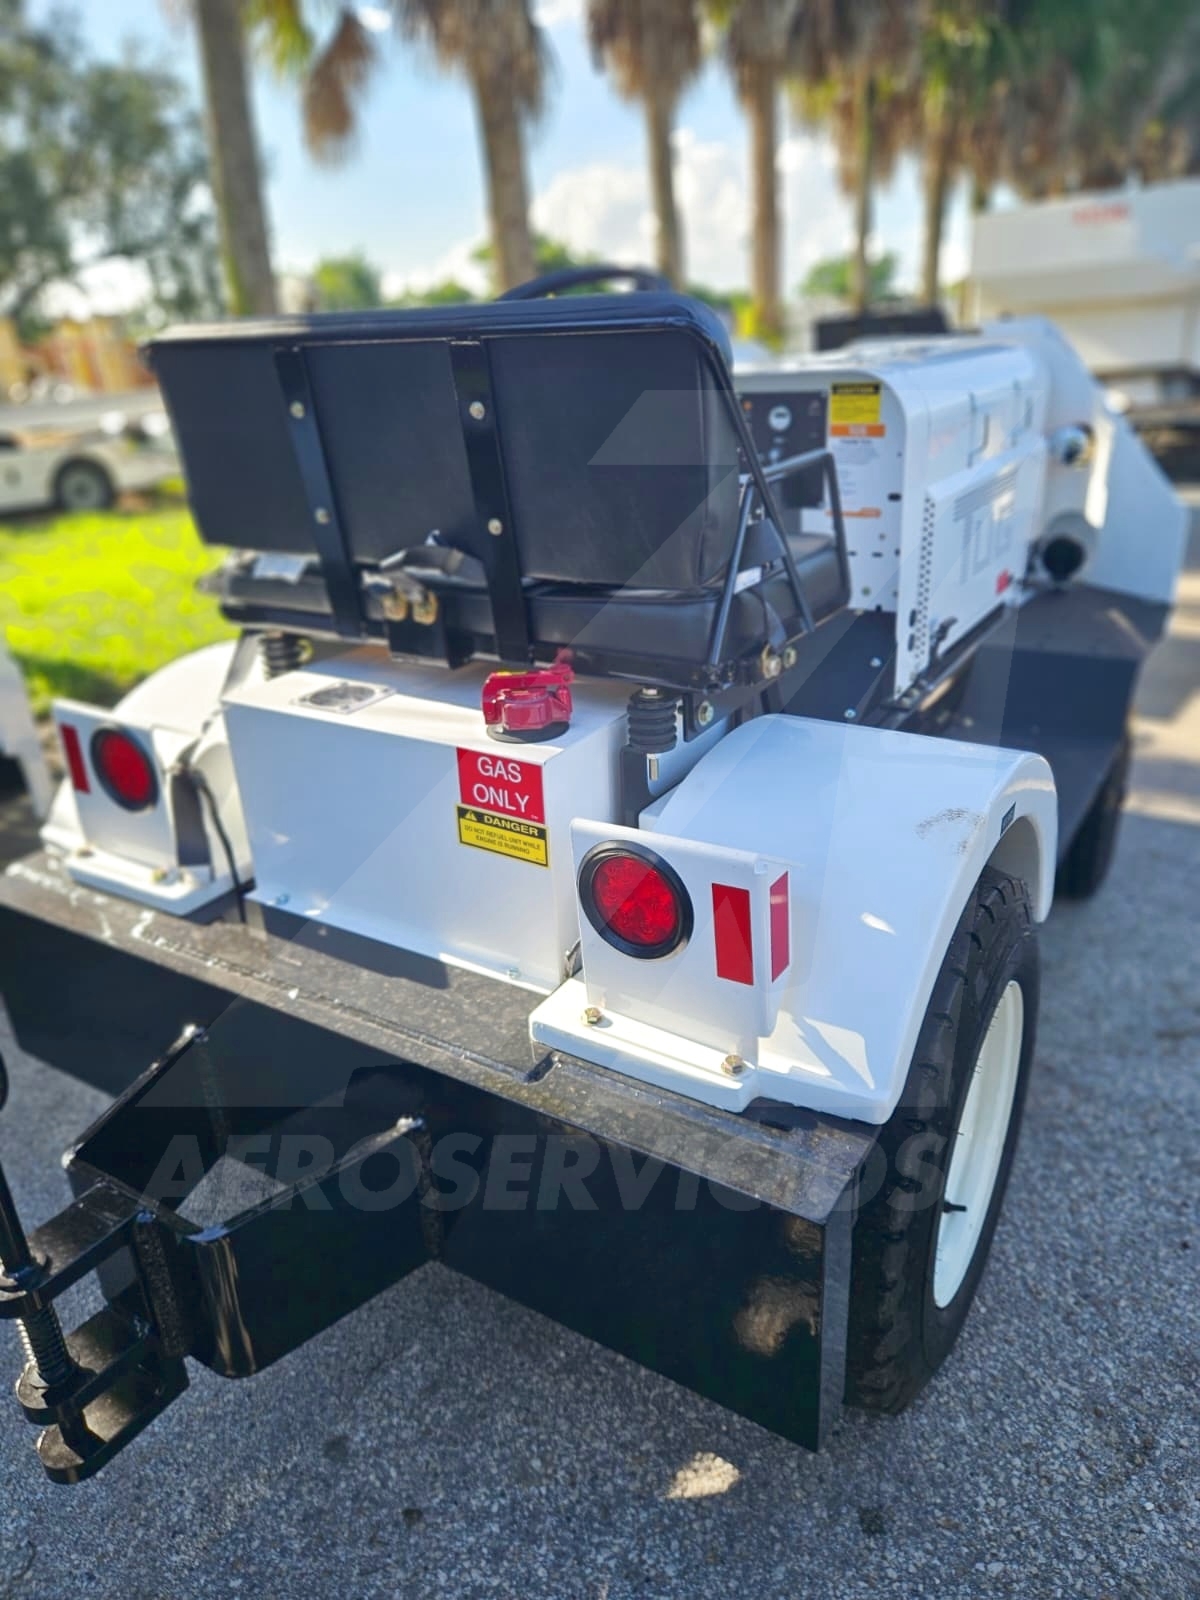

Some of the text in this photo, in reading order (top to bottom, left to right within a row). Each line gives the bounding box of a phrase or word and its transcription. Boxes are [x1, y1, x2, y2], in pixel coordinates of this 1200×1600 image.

[477, 756, 522, 783] GAS
[473, 783, 530, 813] ONLY
[484, 815, 539, 836] DANGER
[486, 830, 508, 842] REFUEL
